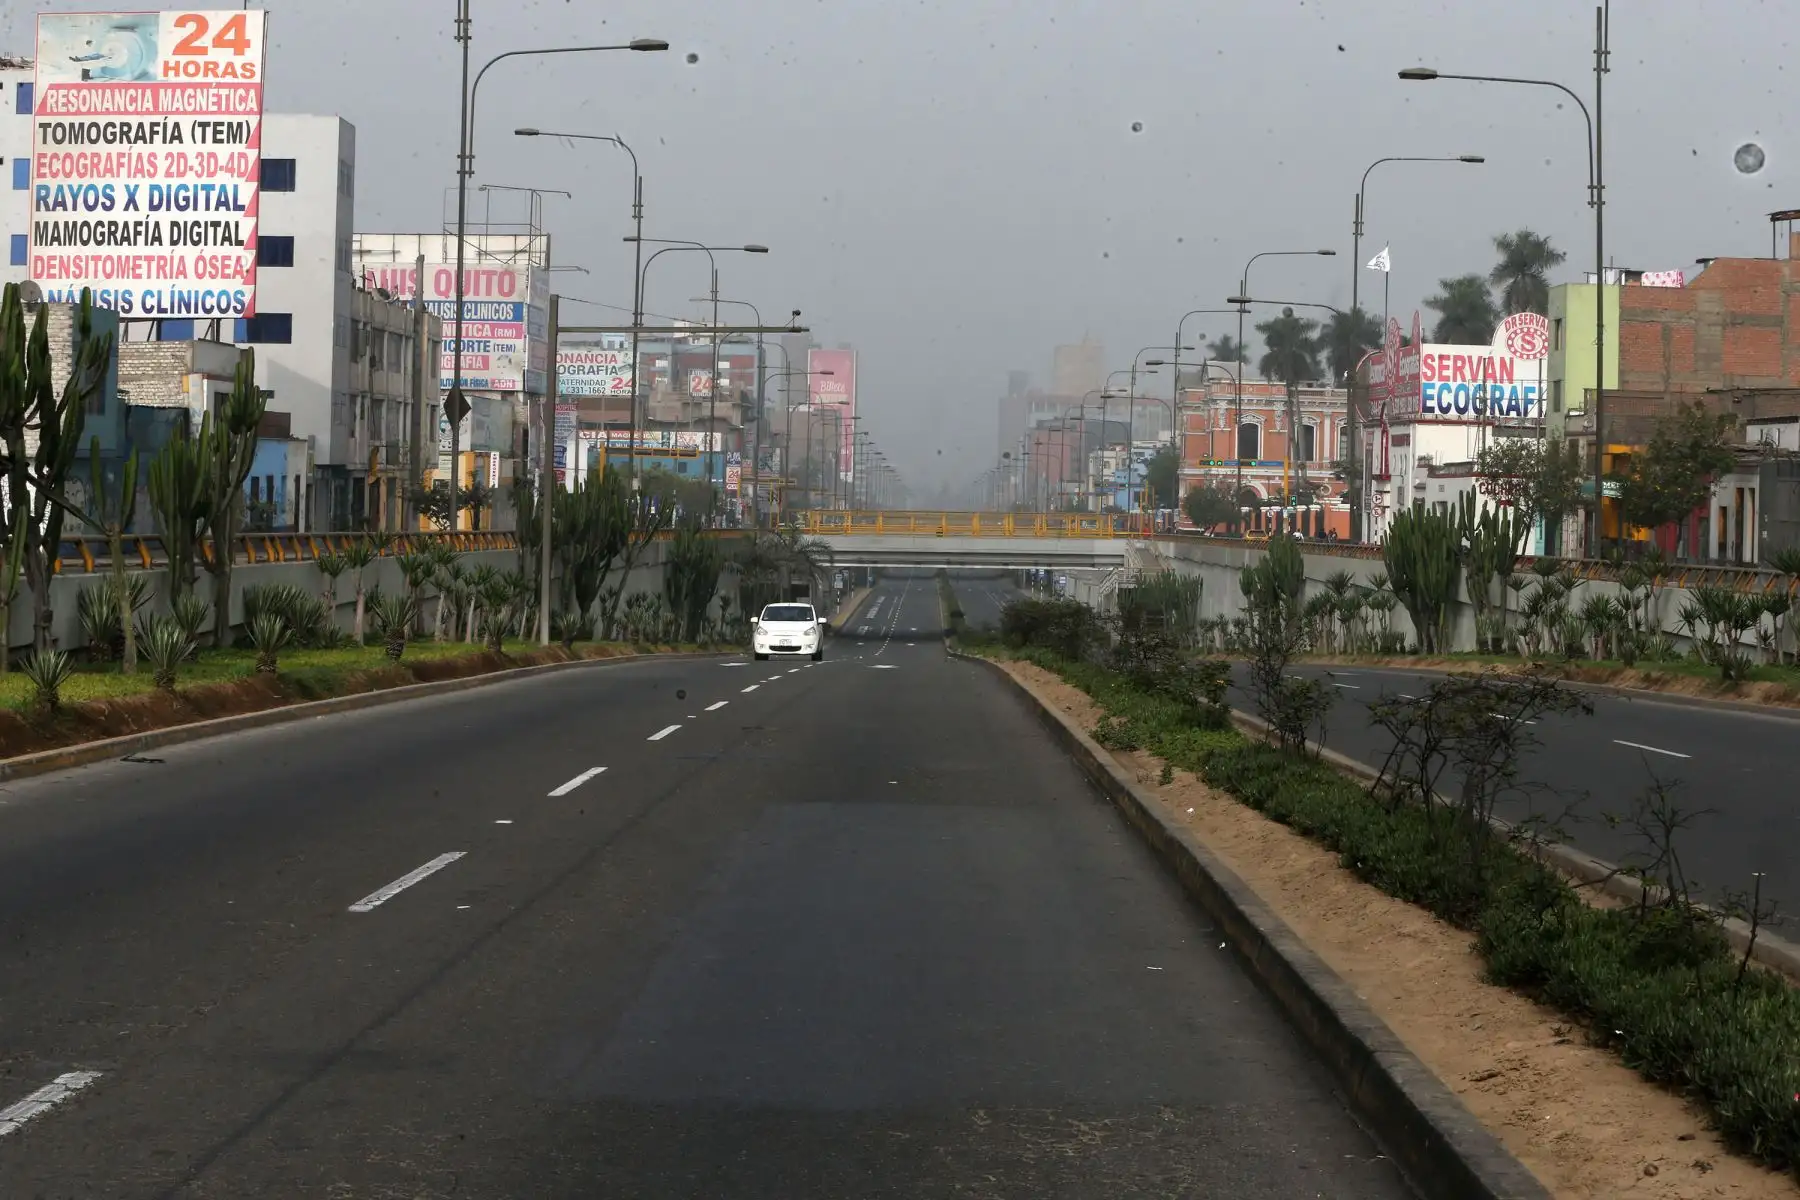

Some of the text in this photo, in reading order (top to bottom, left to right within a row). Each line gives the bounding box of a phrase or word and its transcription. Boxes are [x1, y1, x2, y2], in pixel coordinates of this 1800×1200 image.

[172, 13, 251, 56] 24
[162, 60, 257, 80] HORAS
[46, 82, 258, 113] RESONANCIA MAGNÉTICA
[38, 116, 251, 145] TOMOGRAFÍA (TEM)
[35, 146, 250, 179] ECOGRAFÍAS 2D-3D-4D
[35, 183, 246, 212] RAYOS X DIGITAL
[33, 214, 245, 247] MAMOGRAFÍA DIGITAL
[33, 249, 246, 280] DENSITOMETRÍA ÓSEA
[433, 268, 516, 298] QUITO
[141, 284, 246, 315] CLÍNICOS
[463, 302, 514, 321] CLINICOS
[493, 342, 516, 353] (TEM)
[494, 327, 516, 339] (RM)
[493, 379, 513, 388] ADN
[1421, 353, 1515, 385] SERVAN
[571, 386, 606, 394] 331-1662
